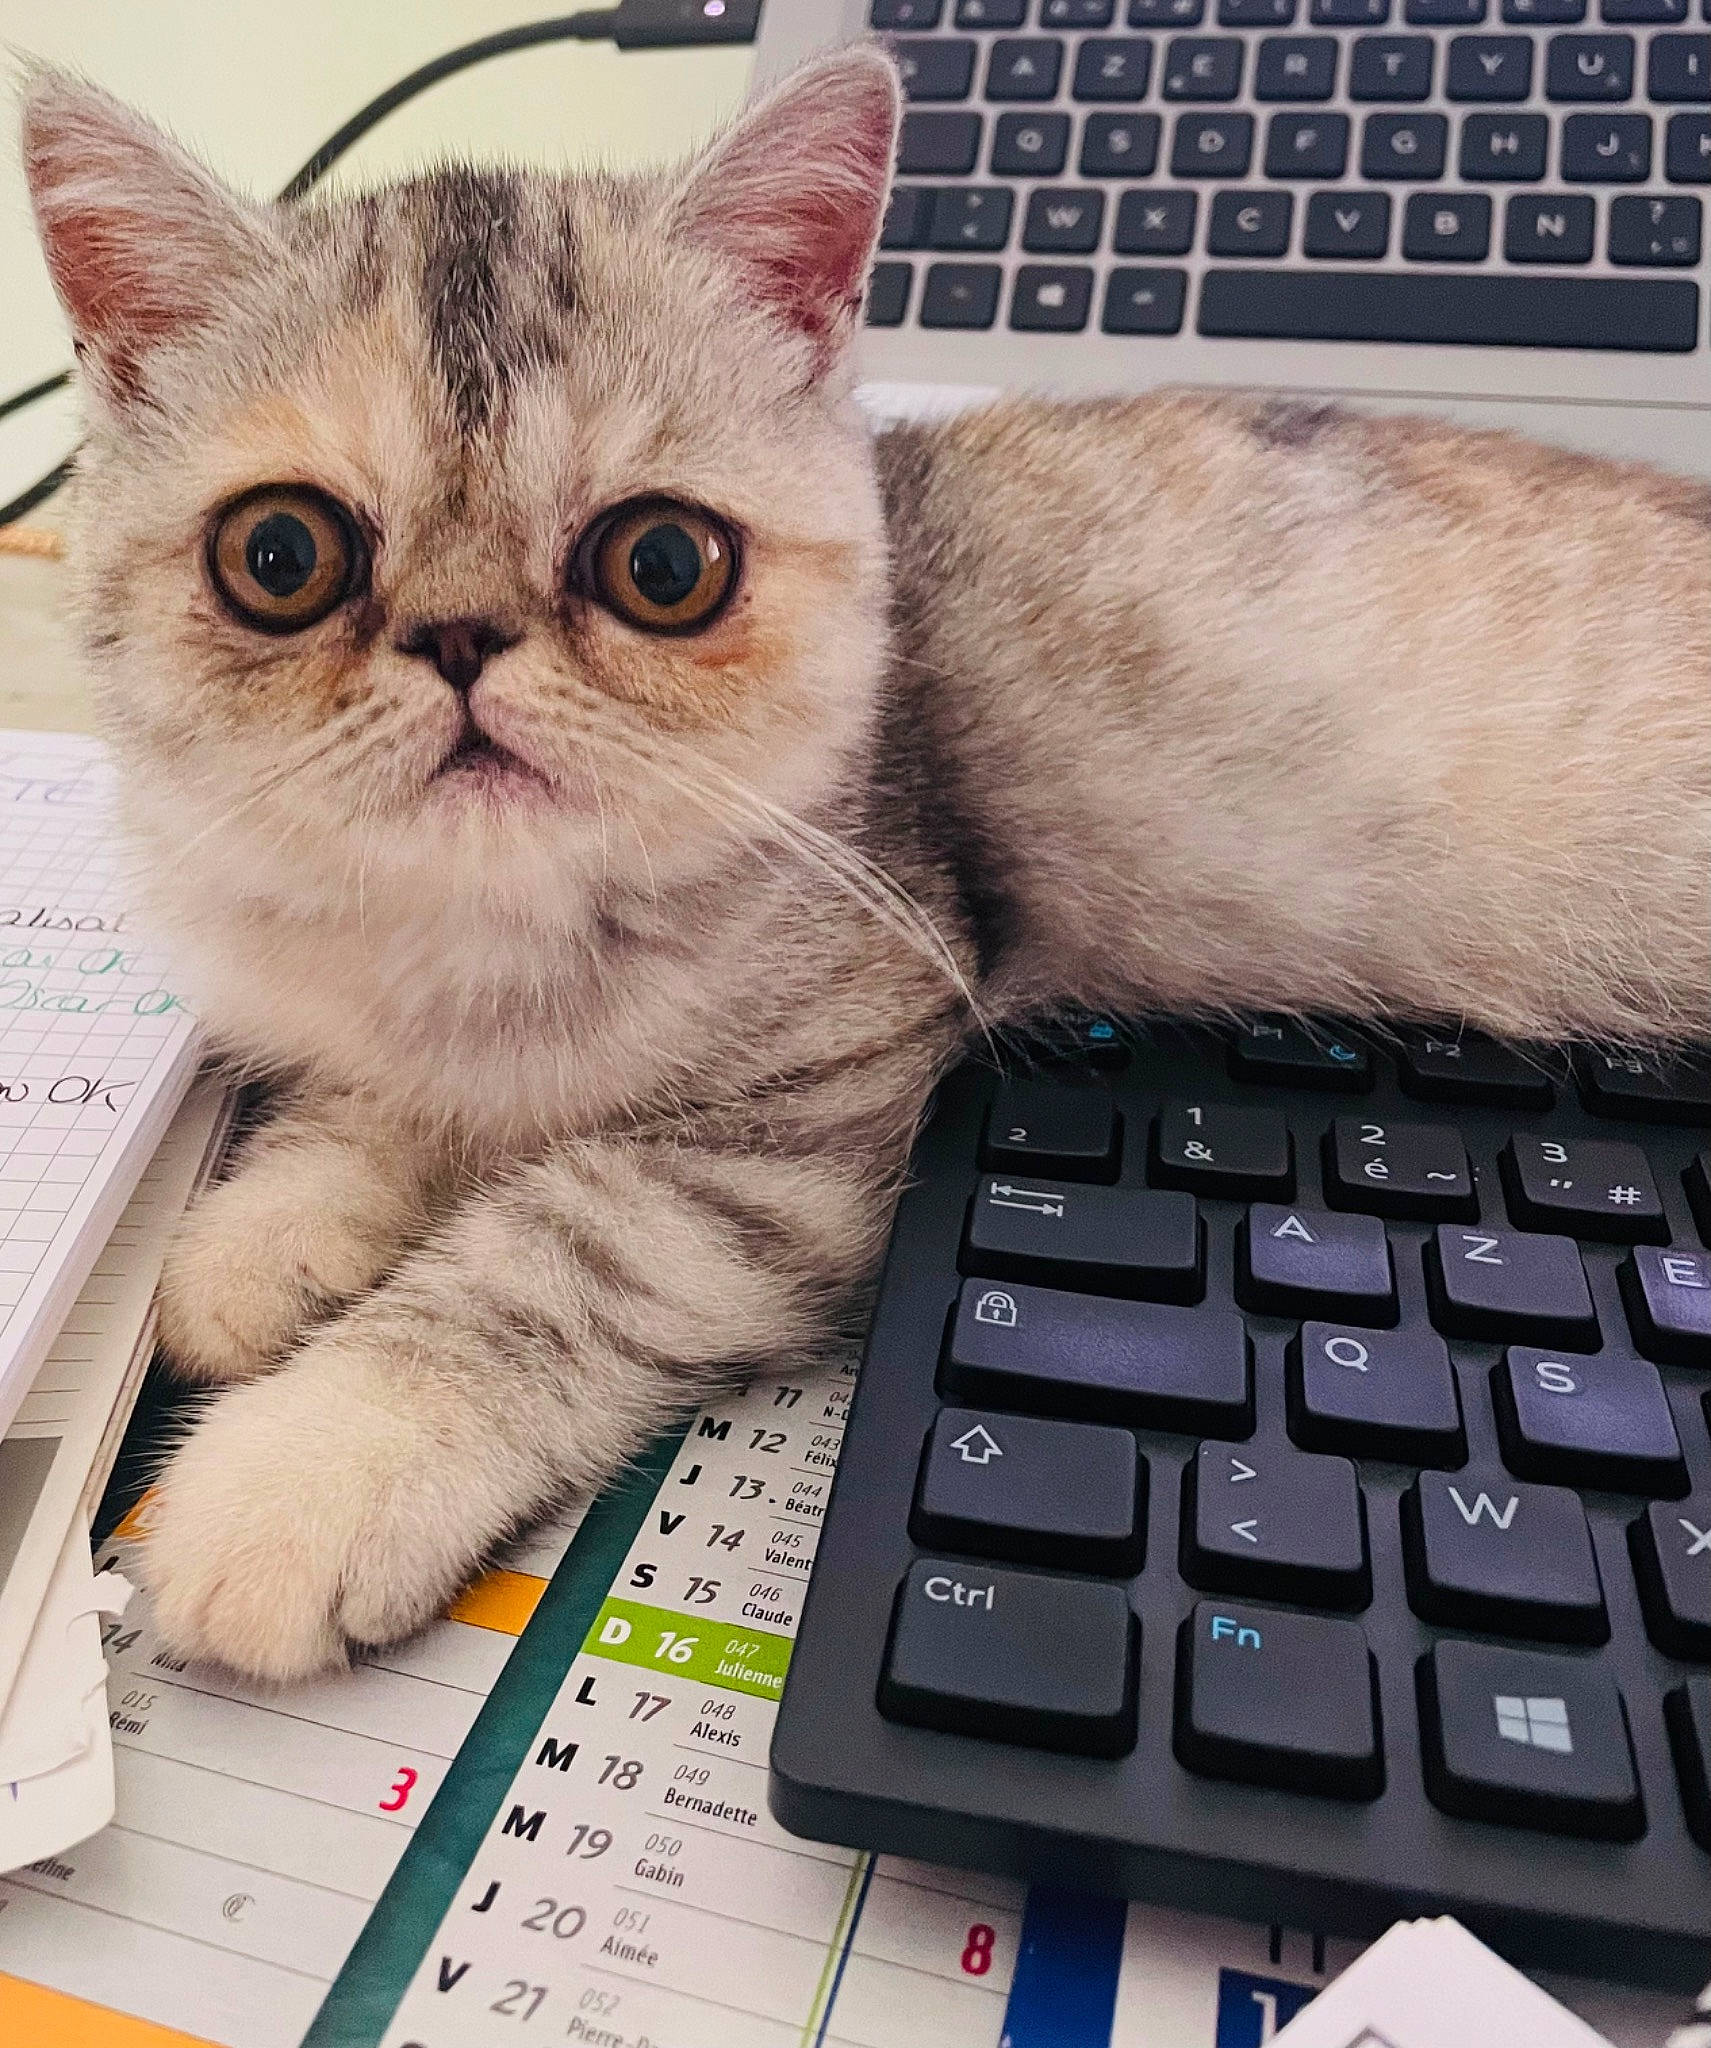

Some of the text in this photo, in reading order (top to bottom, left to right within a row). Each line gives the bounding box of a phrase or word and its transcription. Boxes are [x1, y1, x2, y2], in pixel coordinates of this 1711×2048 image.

[1010, 56, 1036, 78] A
[1102, 54, 1127, 78] Z
[1191, 53, 1214, 77] E
[1382, 52, 1405, 76] T
[1479, 52, 1504, 76] Y
[1576, 52, 1604, 76] U
[1489, 130, 1520, 156] H
[1595, 131, 1621, 156] J
[1046, 205, 1083, 231] W
[1142, 206, 1168, 231] X
[1235, 206, 1264, 234] C
[1334, 208, 1362, 233] V
[1535, 213, 1567, 238] N
[49, 1076, 137, 1113] OK
[1186, 1106, 1202, 1125] 1
[1361, 1124, 1387, 1146] 2
[1183, 1140, 1215, 1163] &
[1541, 1141, 1568, 1163] 3
[1364, 1157, 1389, 1180] é
[1607, 1185, 1642, 1205] #
[1272, 1214, 1317, 1244] A
[1462, 1233, 1504, 1266] Z
[1661, 1256, 1704, 1288] E
[1324, 1336, 1370, 1373] Q
[1535, 1360, 1578, 1394] S
[697, 1415, 841, 1454] M 12 043
[679, 1464, 824, 1500] J 13 044
[1447, 1485, 1520, 1530] W
[659, 1510, 804, 1553] V 14 045
[629, 1562, 784, 1604] S 15 046
[924, 1576, 996, 1611] Ctrl
[741, 1601, 794, 1627] Claude
[598, 1616, 761, 1664] D 16 047
[1211, 1615, 1263, 1651] Fn
[714, 1659, 785, 1689] Julienne
[121, 1690, 159, 1712] 015
[574, 1675, 737, 1723] L 17 048
[689, 1721, 742, 1748] Alexis
[535, 1737, 712, 1791] M 18 049
[377, 1766, 419, 1812] 3
[663, 1786, 758, 1827] Bernadette
[501, 1803, 684, 1860] M 19 050
[634, 1857, 686, 1889] Gabin
[471, 1880, 652, 1940] J 20 051
[599, 1934, 660, 1968] Aimée
[961, 1922, 996, 1977] 8
[436, 1955, 622, 2022] V 21 052
